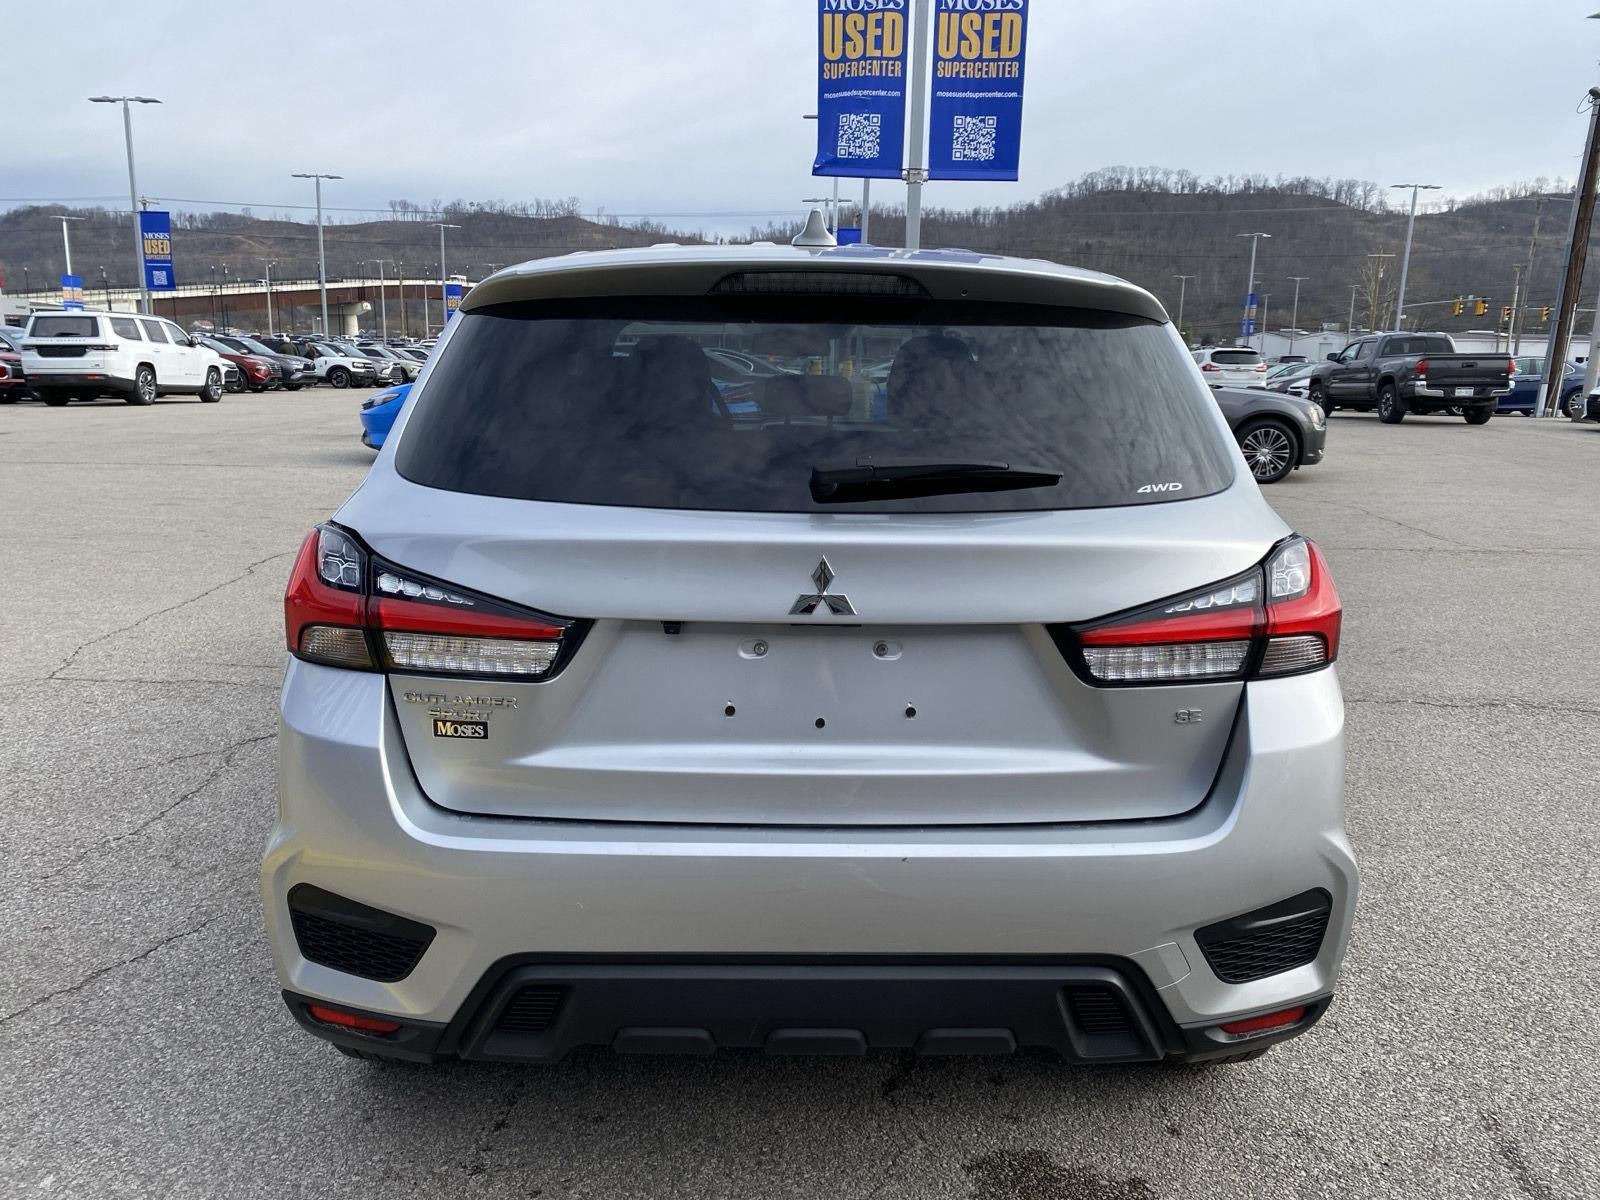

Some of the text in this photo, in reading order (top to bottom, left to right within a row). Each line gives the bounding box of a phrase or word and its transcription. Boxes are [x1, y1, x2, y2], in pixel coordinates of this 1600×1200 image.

[823, 12, 903, 60] USED
[938, 12, 1022, 59] USED
[824, 60, 901, 79] SUPERCENTER
[937, 61, 1018, 78] SUPERCENTER
[824, 90, 901, 99] mosesusedsupercenter.com
[936, 91, 1017, 99] mosesusedsupercenter.com
[144, 240, 170, 254] USED
[1137, 483, 1182, 493] 4WD
[403, 691, 518, 709] OUTLANDER
[428, 707, 493, 720] SPORT
